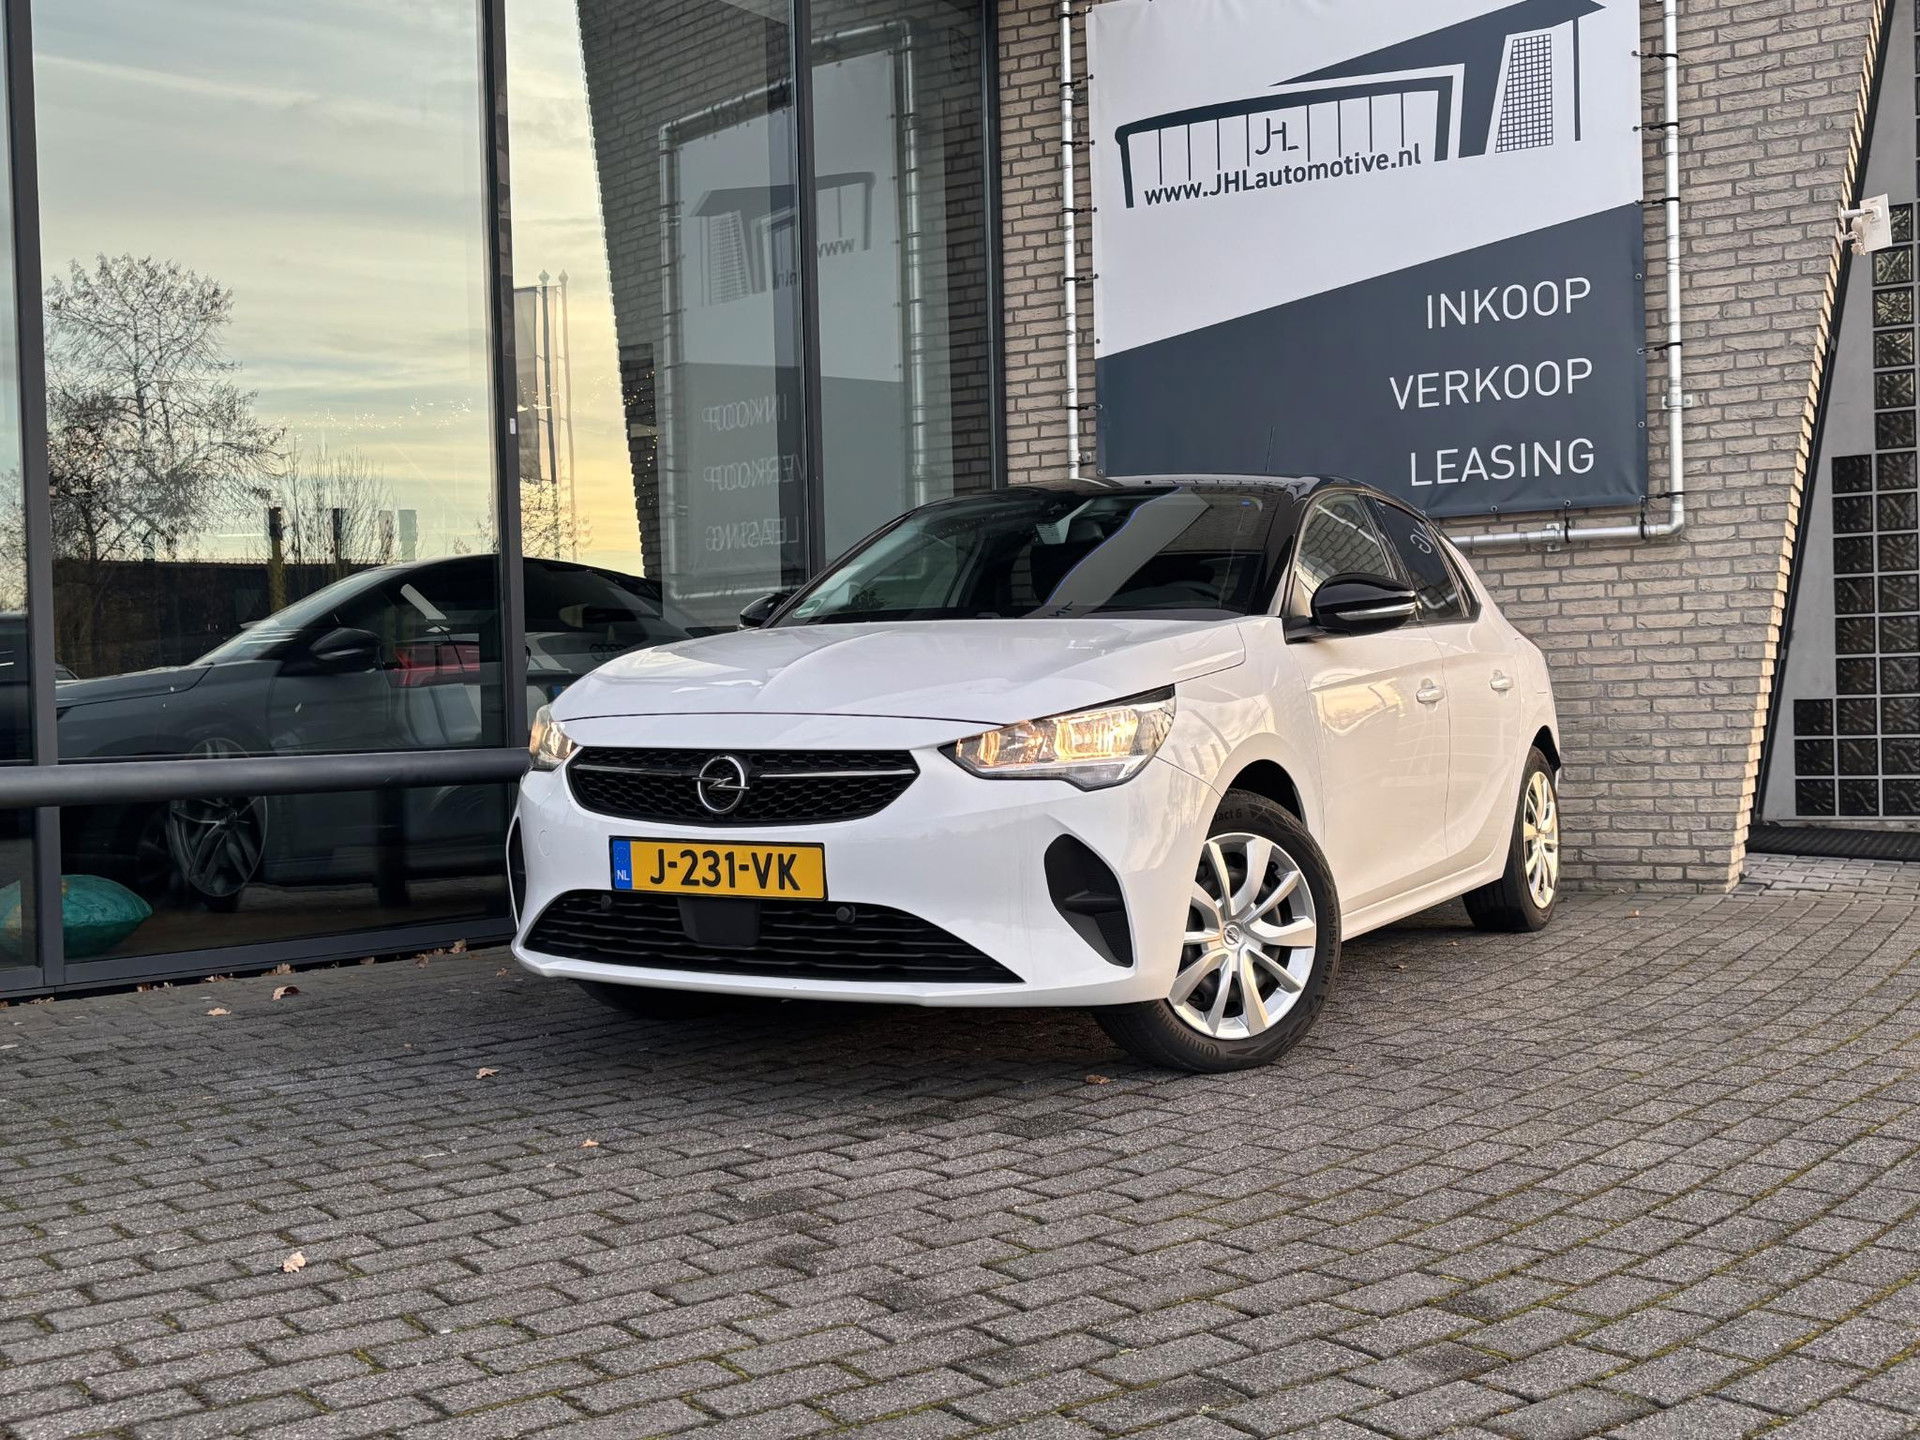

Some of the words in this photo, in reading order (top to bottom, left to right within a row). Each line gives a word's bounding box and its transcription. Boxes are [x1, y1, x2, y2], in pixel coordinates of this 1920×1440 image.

[1144, 143, 1421, 206] www.JHLautomotive.nl
[1427, 277, 1592, 330] INKOOP
[1389, 358, 1593, 411] VERKOOP
[1410, 438, 1595, 487] LEASING
[616, 870, 630, 881] NL
[650, 848, 801, 891] J-231-VK
